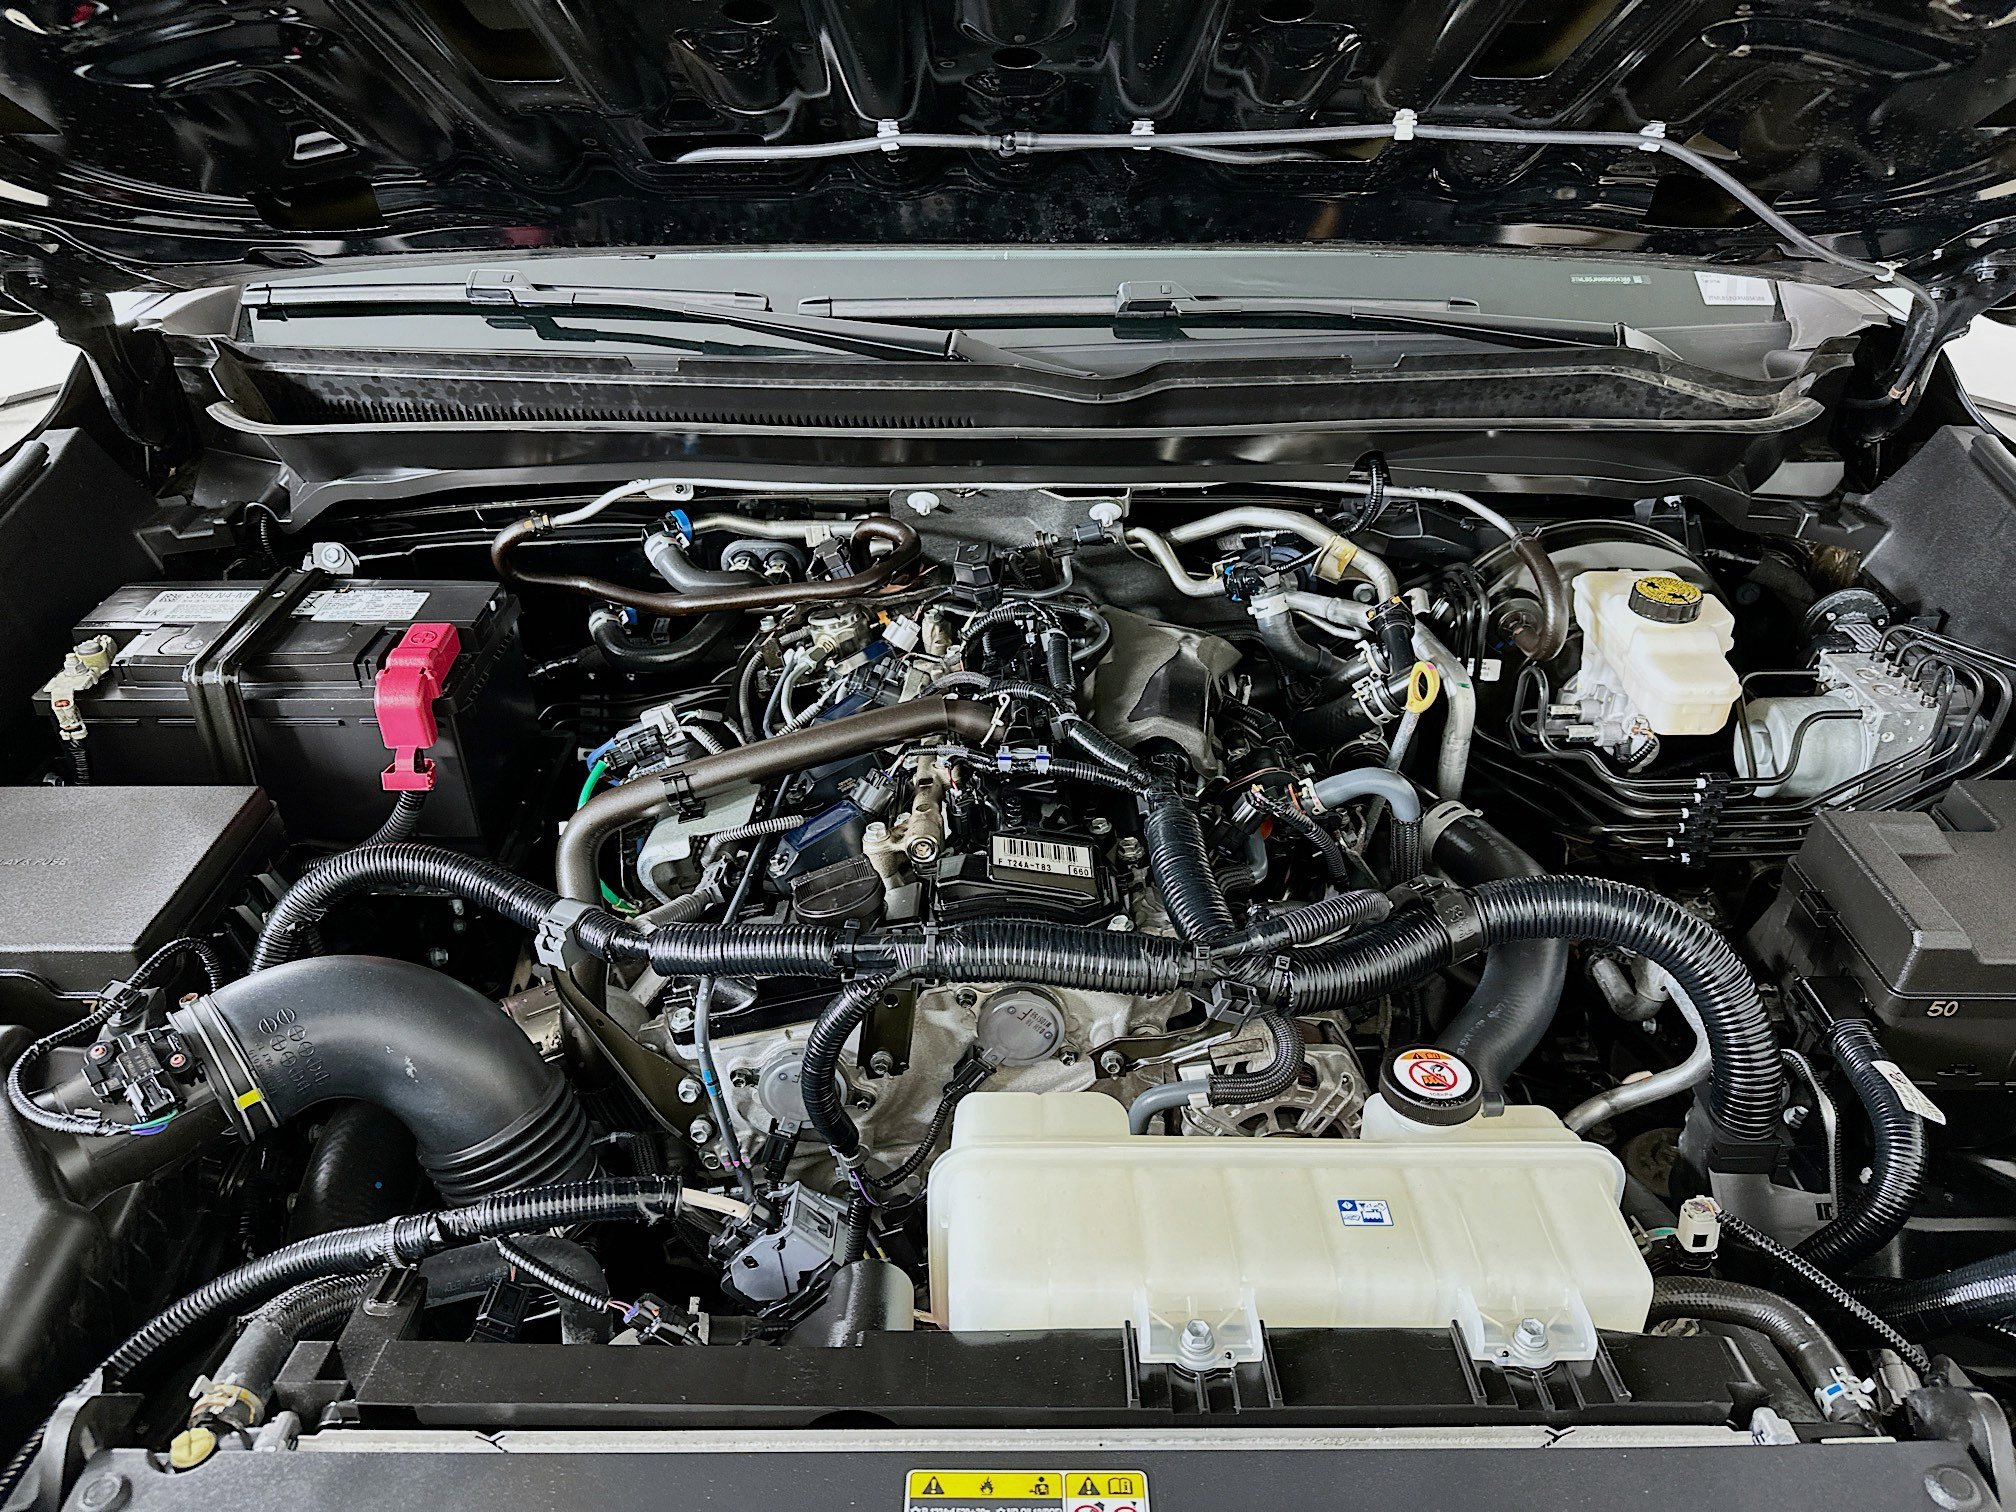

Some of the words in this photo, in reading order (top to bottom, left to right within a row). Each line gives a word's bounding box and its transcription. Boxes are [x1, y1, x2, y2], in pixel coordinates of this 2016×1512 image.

[33, 858, 68, 866] FUSE
[1008, 859, 1052, 872] T24A-T83
[1926, 1000, 1959, 1017] 50
